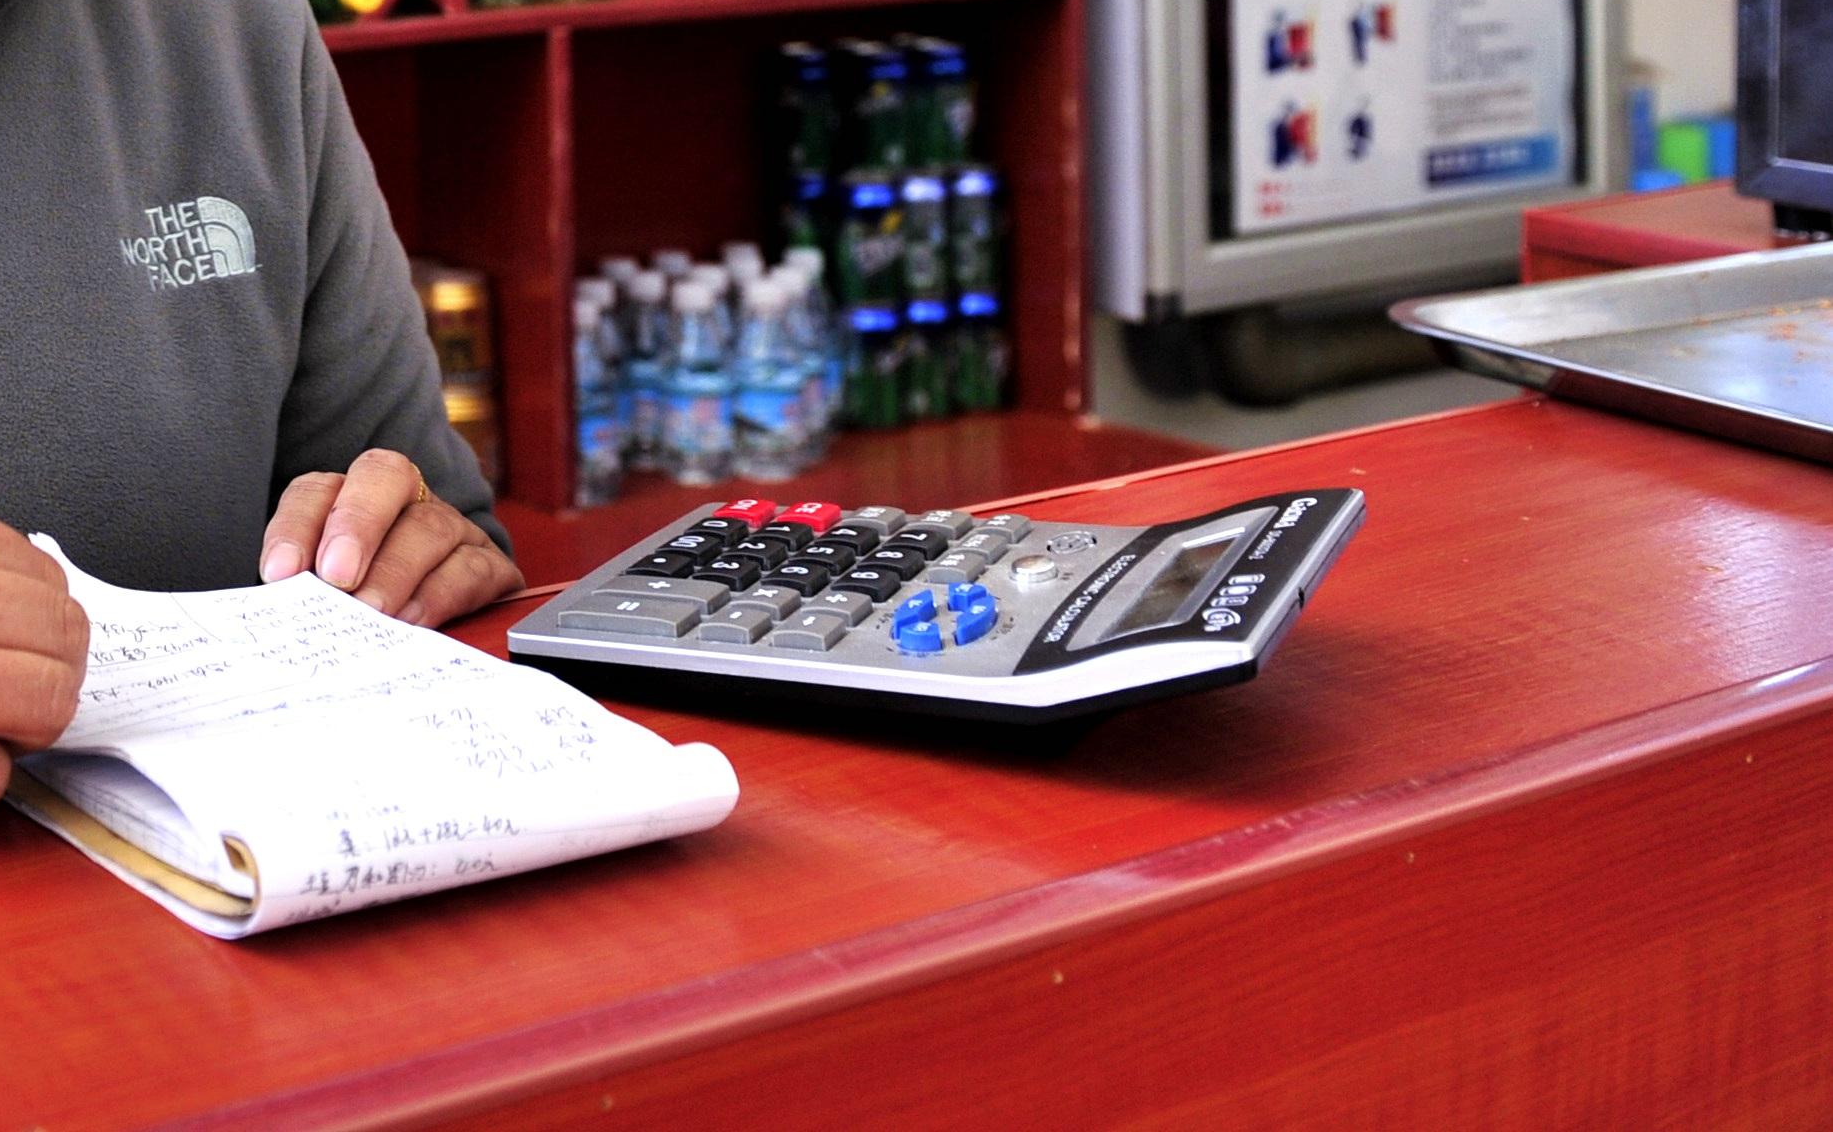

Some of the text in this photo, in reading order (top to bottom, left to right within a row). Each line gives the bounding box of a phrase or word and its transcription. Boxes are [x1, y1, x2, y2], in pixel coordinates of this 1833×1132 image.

[144, 201, 201, 236] THE
[119, 226, 210, 267] NORTH
[146, 254, 216, 293] FACE
[764, 525, 791, 533] 1
[831, 528, 858, 536] 4
[669, 535, 706, 548] 00
[900, 533, 928, 541] 7
[737, 542, 767, 550] 2
[805, 546, 835, 555] 5
[875, 550, 904, 559] 8
[711, 560, 741, 571] 3
[780, 565, 809, 575] 6
[850, 570, 880, 580] 9
